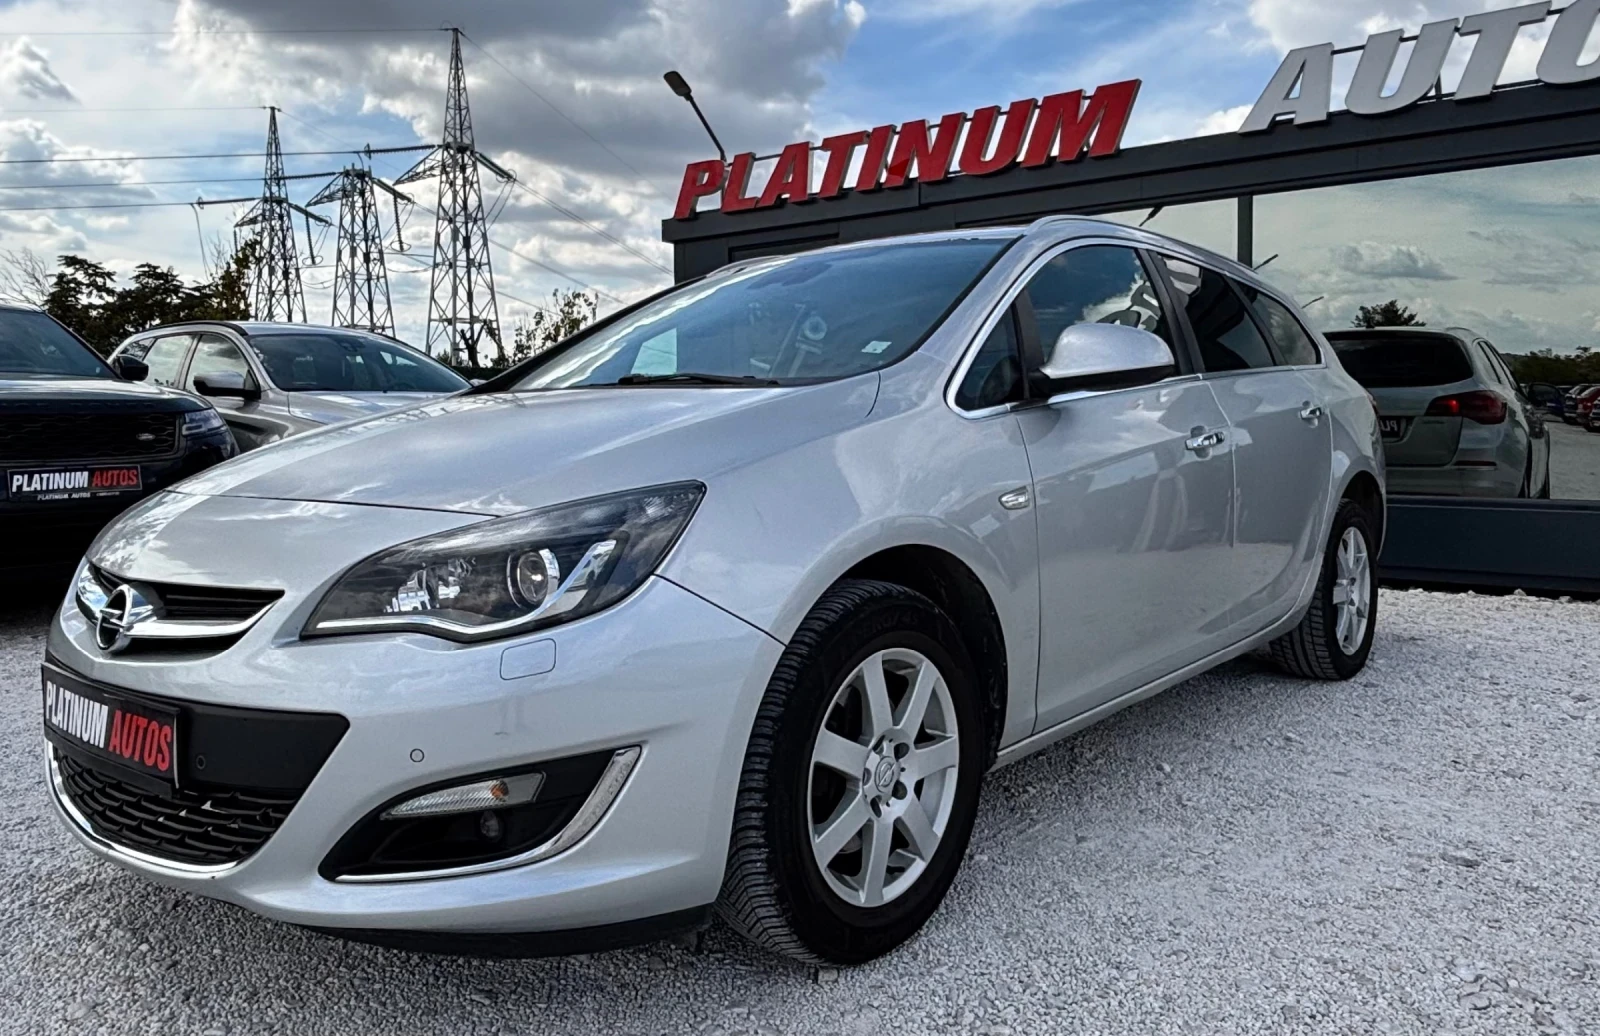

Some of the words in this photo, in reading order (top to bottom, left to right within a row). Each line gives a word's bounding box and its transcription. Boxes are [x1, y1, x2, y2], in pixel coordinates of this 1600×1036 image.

[674, 79, 1141, 219] PLATINUM
[12, 471, 89, 492] PLATINUM
[92, 469, 137, 487] AUTOS
[46, 680, 109, 748] PLATINUM
[109, 710, 172, 772] AUTOS
